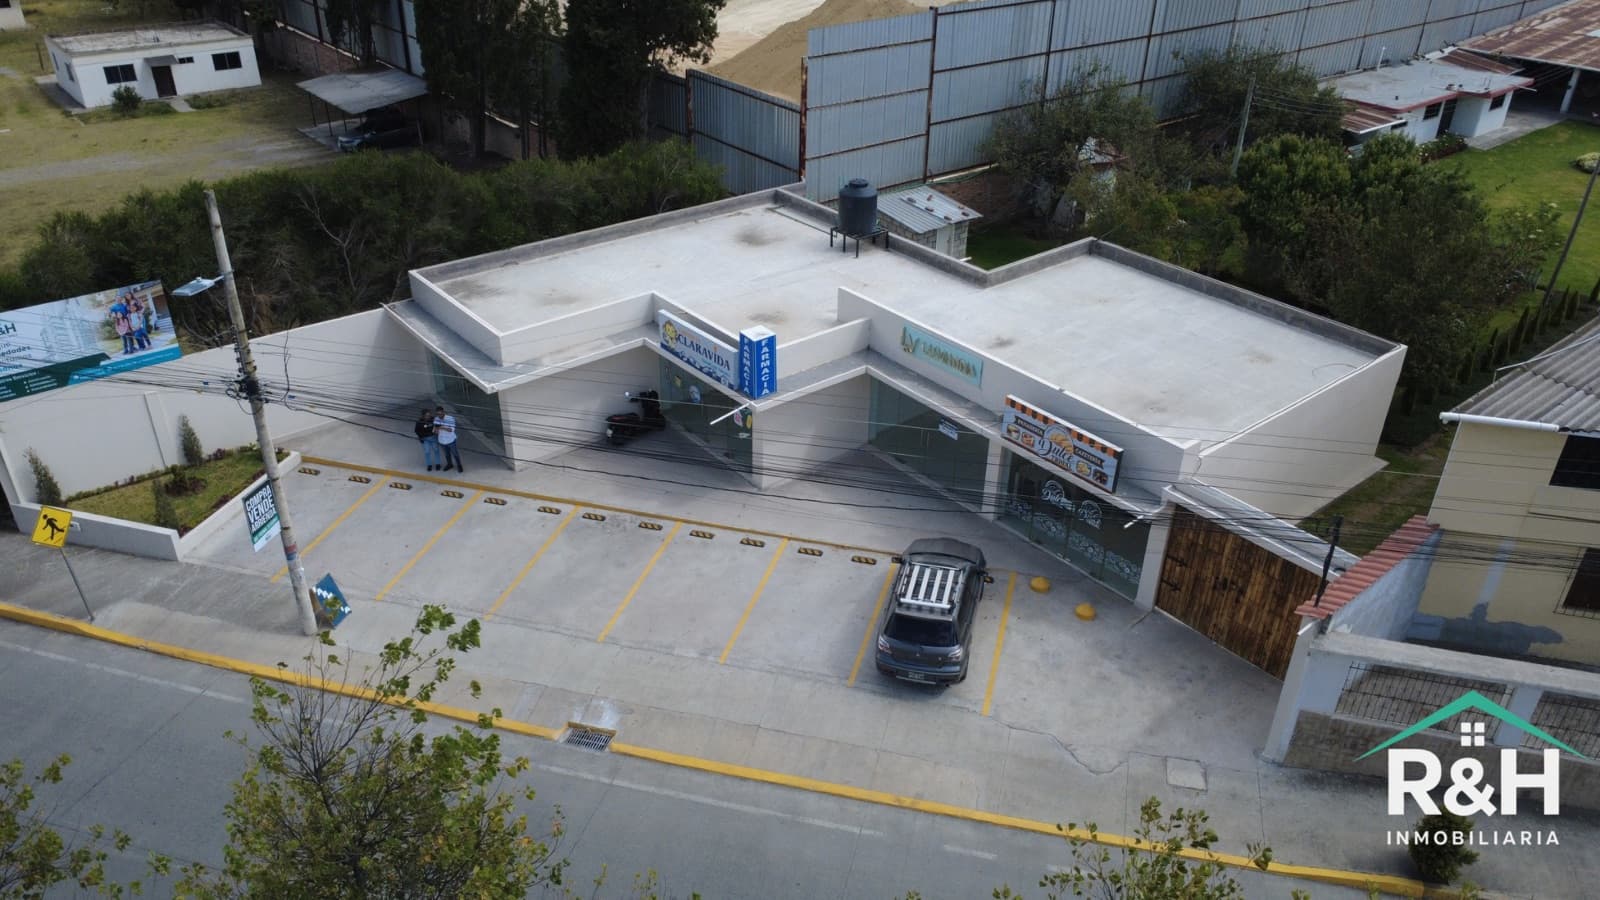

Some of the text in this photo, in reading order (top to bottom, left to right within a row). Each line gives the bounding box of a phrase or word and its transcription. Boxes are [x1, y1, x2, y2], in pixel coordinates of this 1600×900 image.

[676, 333, 730, 371] CLARAVIDA
[743, 338, 751, 394] FARMACIA
[761, 339, 770, 395] FARMACIA
[1038, 438, 1073, 462] Dulce
[245, 485, 271, 511] COMPRA
[248, 495, 274, 523] VENDE
